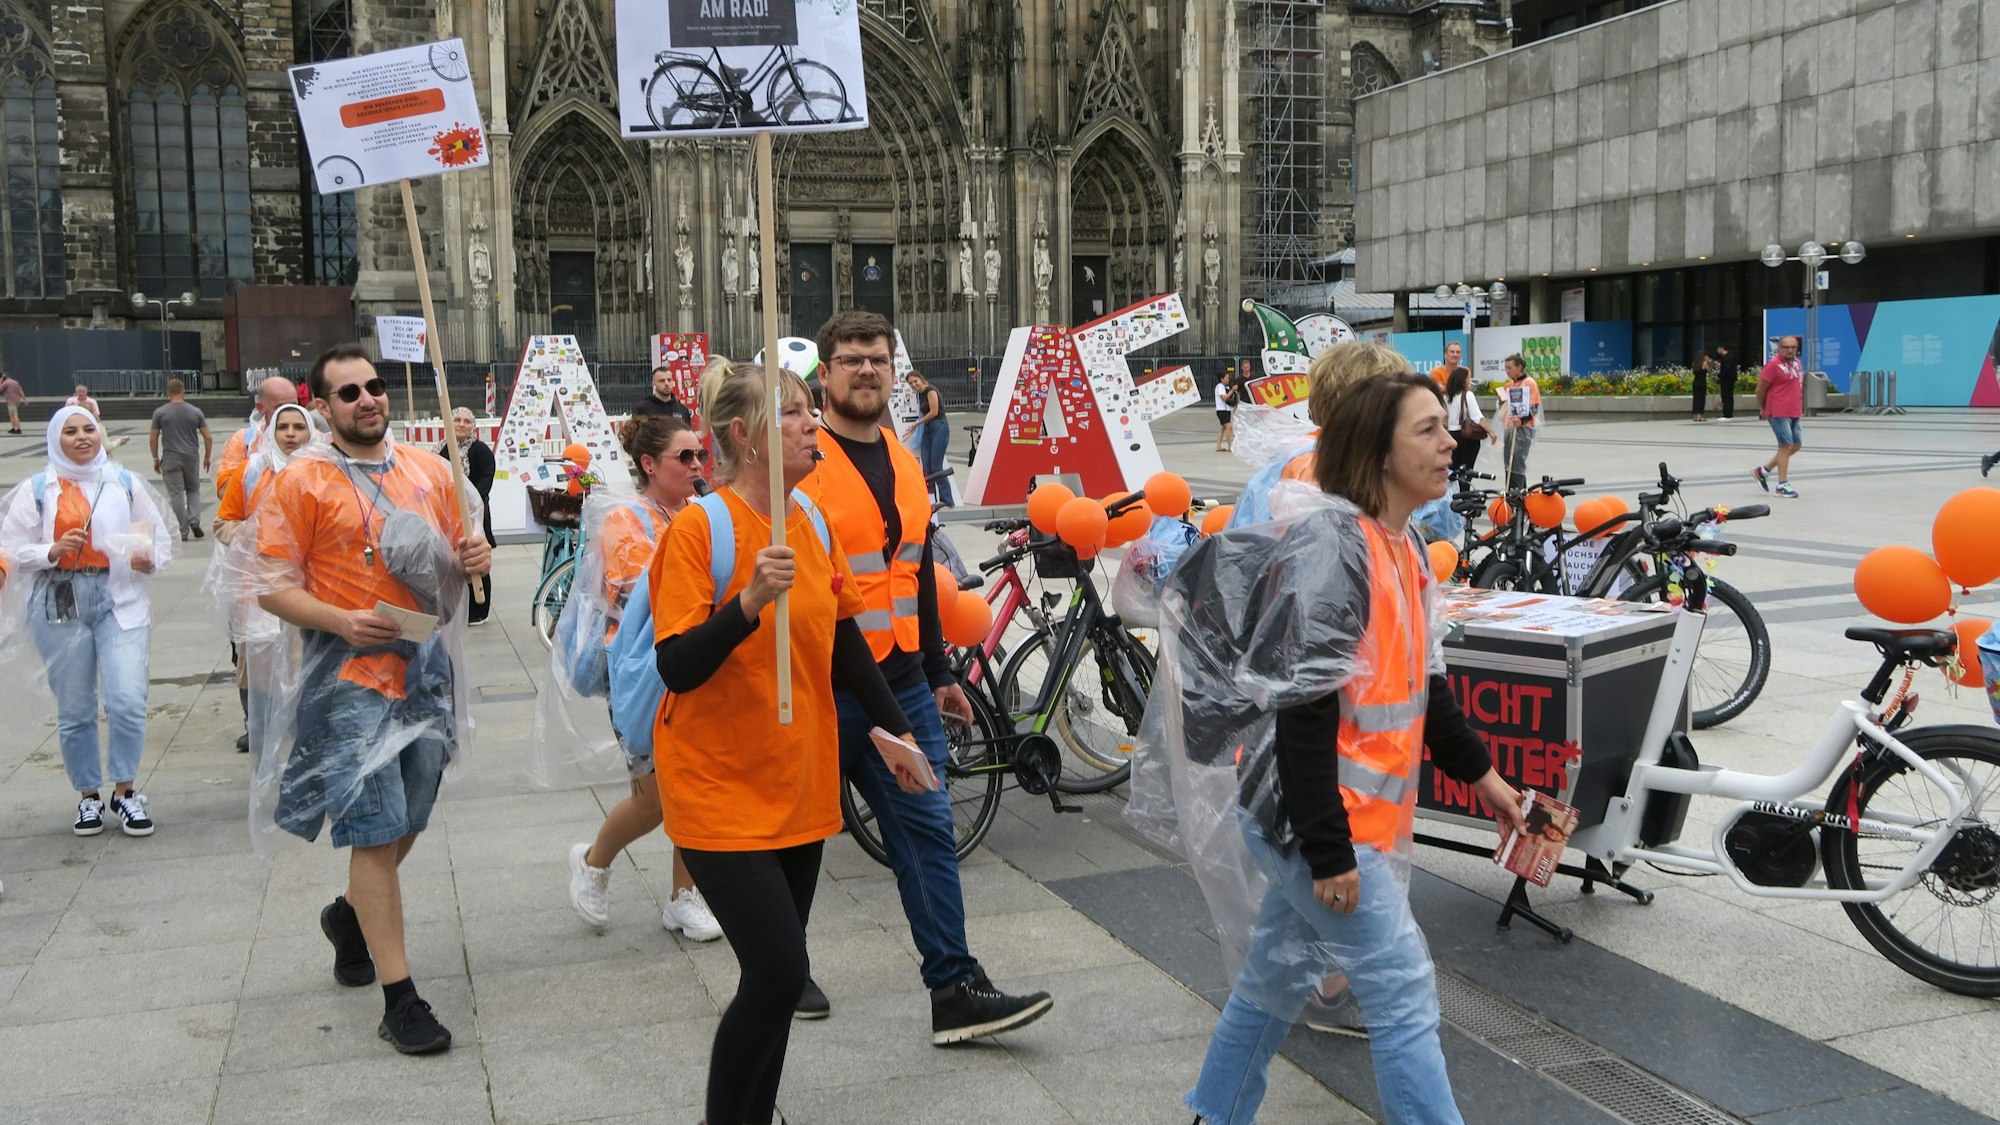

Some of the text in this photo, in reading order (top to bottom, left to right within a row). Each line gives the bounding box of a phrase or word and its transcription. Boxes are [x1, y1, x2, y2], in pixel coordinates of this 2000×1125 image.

[700, 0, 769, 18] AM RAD!
[1567, 550, 1599, 560] ÜCHSE
[1448, 674, 1552, 731] UCHT
[1882, 827, 1912, 837] ARROW
